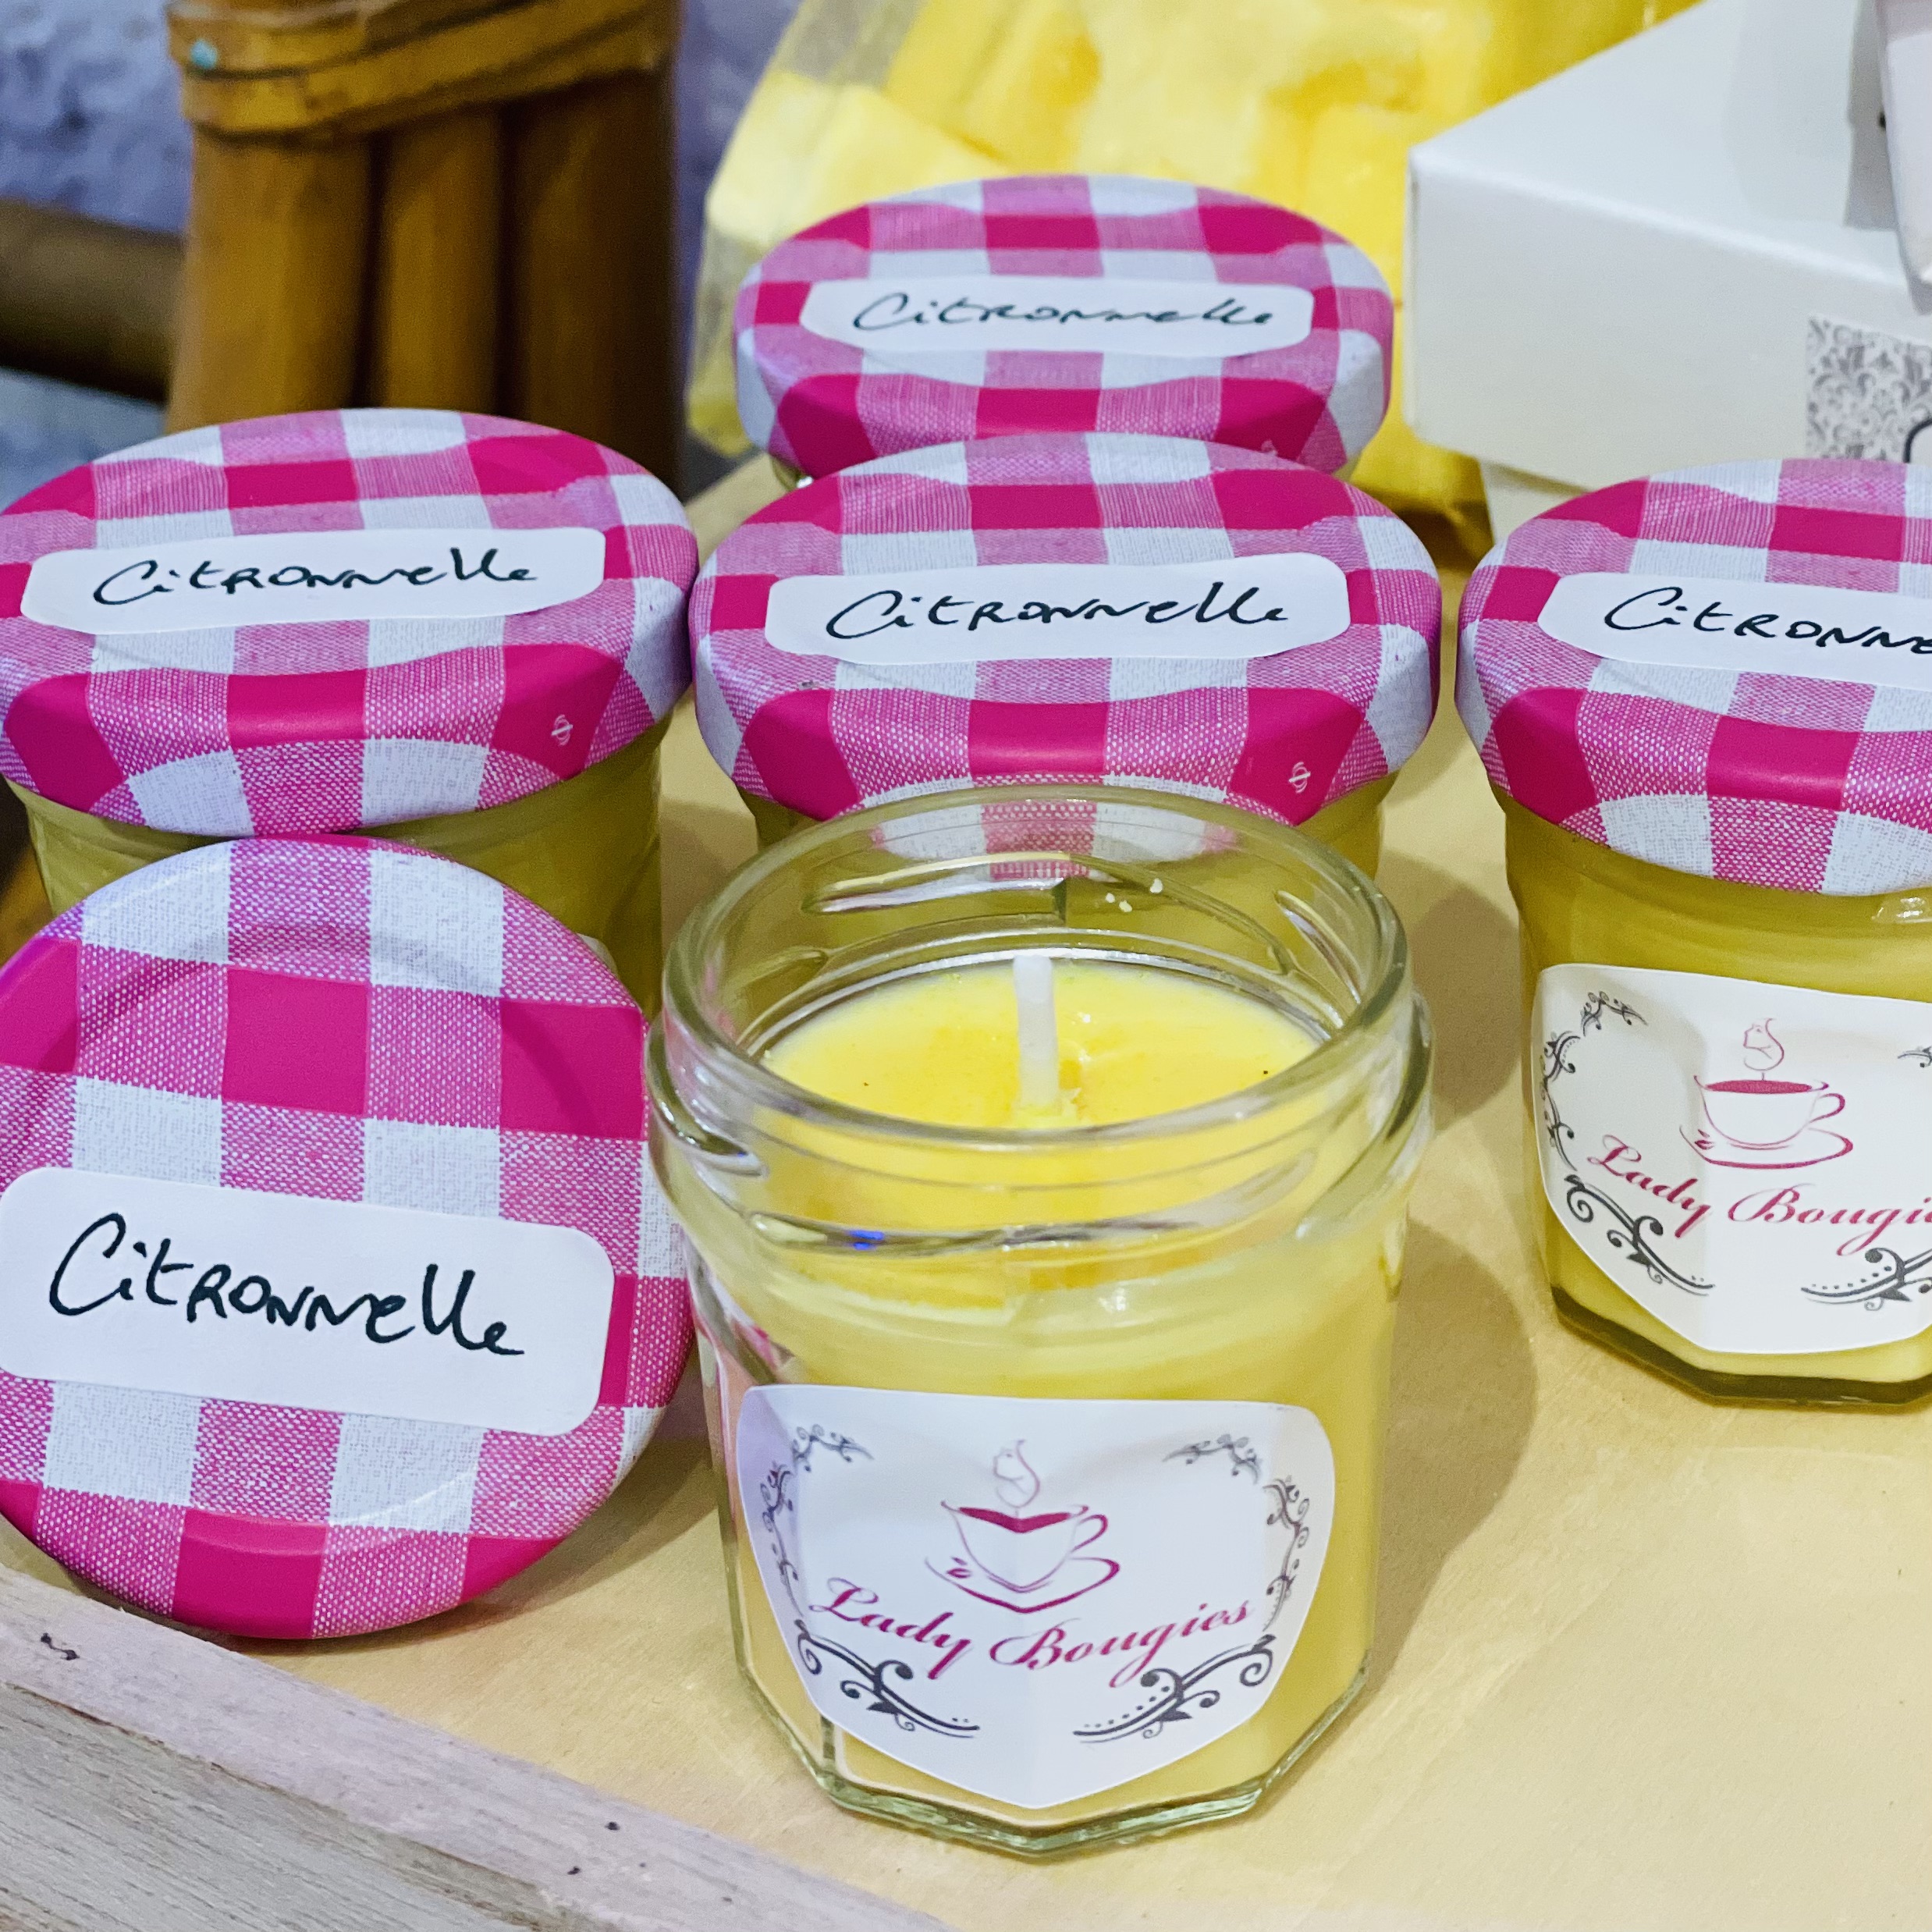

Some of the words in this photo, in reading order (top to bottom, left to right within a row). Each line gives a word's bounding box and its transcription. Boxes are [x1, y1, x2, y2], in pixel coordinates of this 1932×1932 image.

[1586, 1134, 1714, 1239] Lady
[808, 1577, 974, 1681] Lady
[989, 1600, 1252, 1689] Bougies
